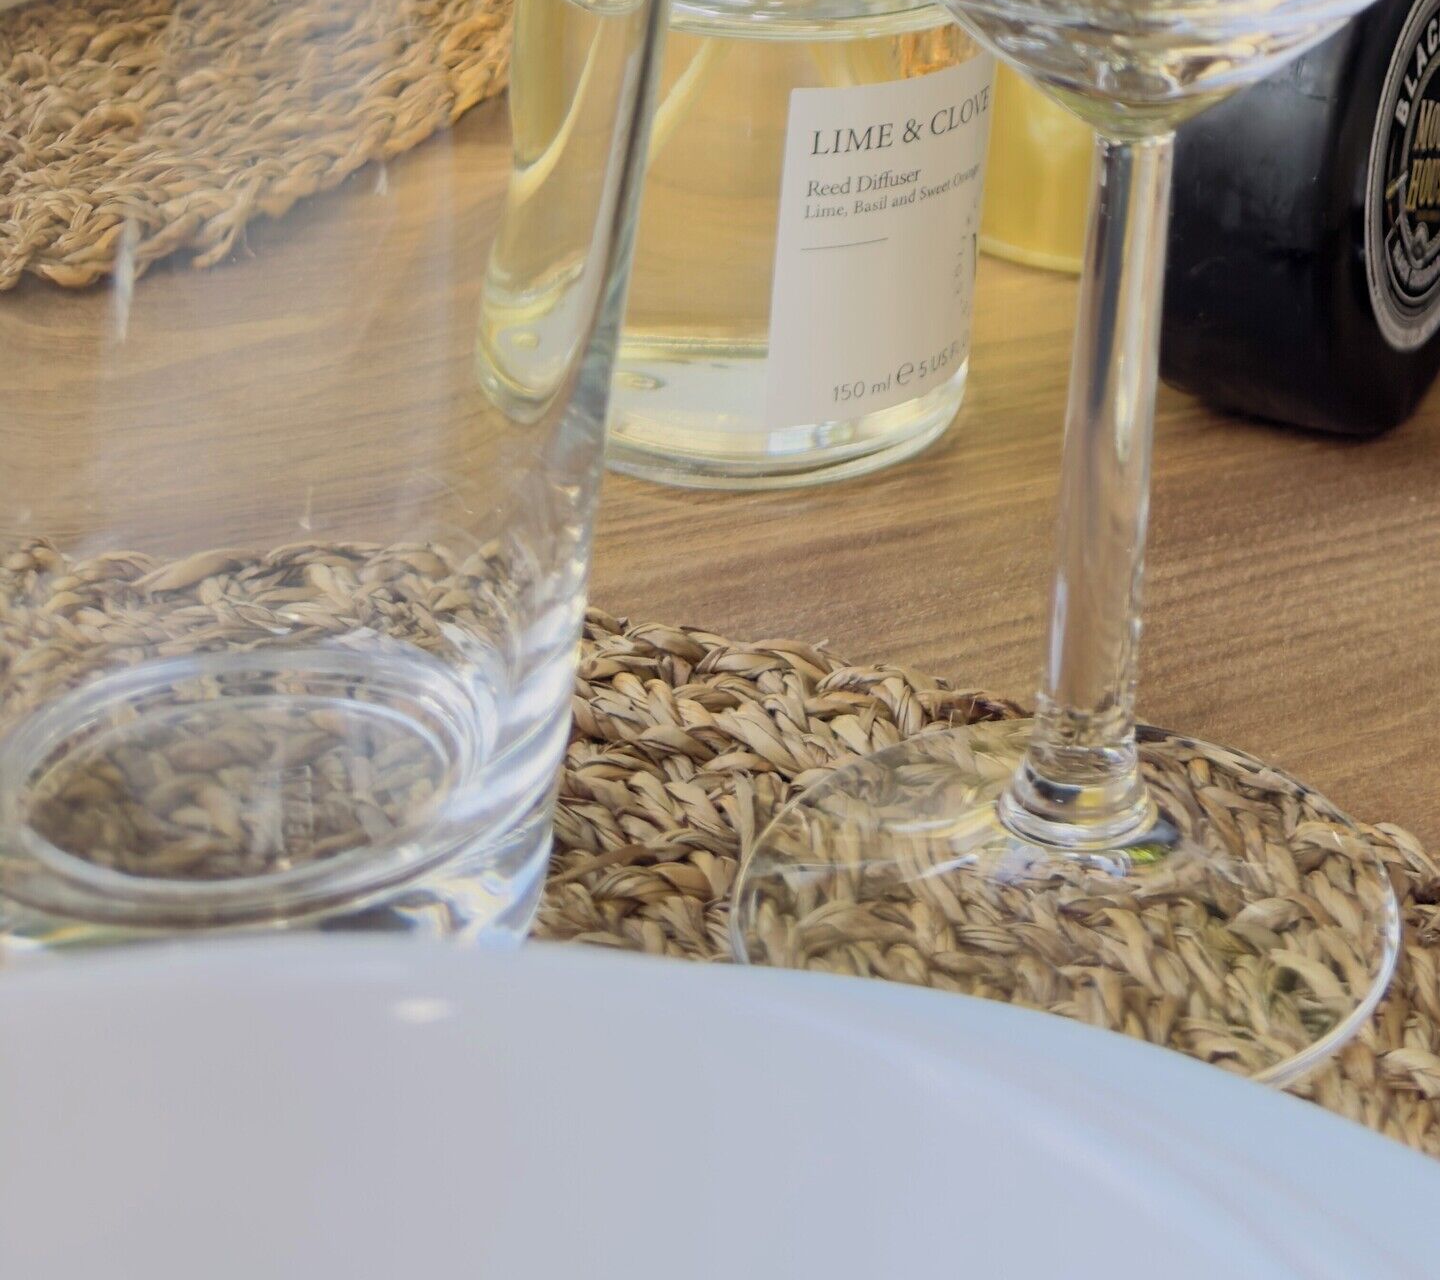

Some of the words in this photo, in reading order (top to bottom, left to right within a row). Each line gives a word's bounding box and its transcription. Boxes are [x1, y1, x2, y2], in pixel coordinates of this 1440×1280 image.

[811, 122, 894, 156] LIME
[902, 118, 924, 144] &
[804, 203, 848, 220] Lime,
[853, 195, 888, 215] Basil
[891, 190, 917, 208] and
[919, 178, 951, 201] Sweet
[806, 174, 851, 198] Reed
[856, 167, 922, 194] Diffuser
[833, 380, 866, 402] 150
[871, 372, 892, 396] ml
[918, 359, 928, 378] 5
